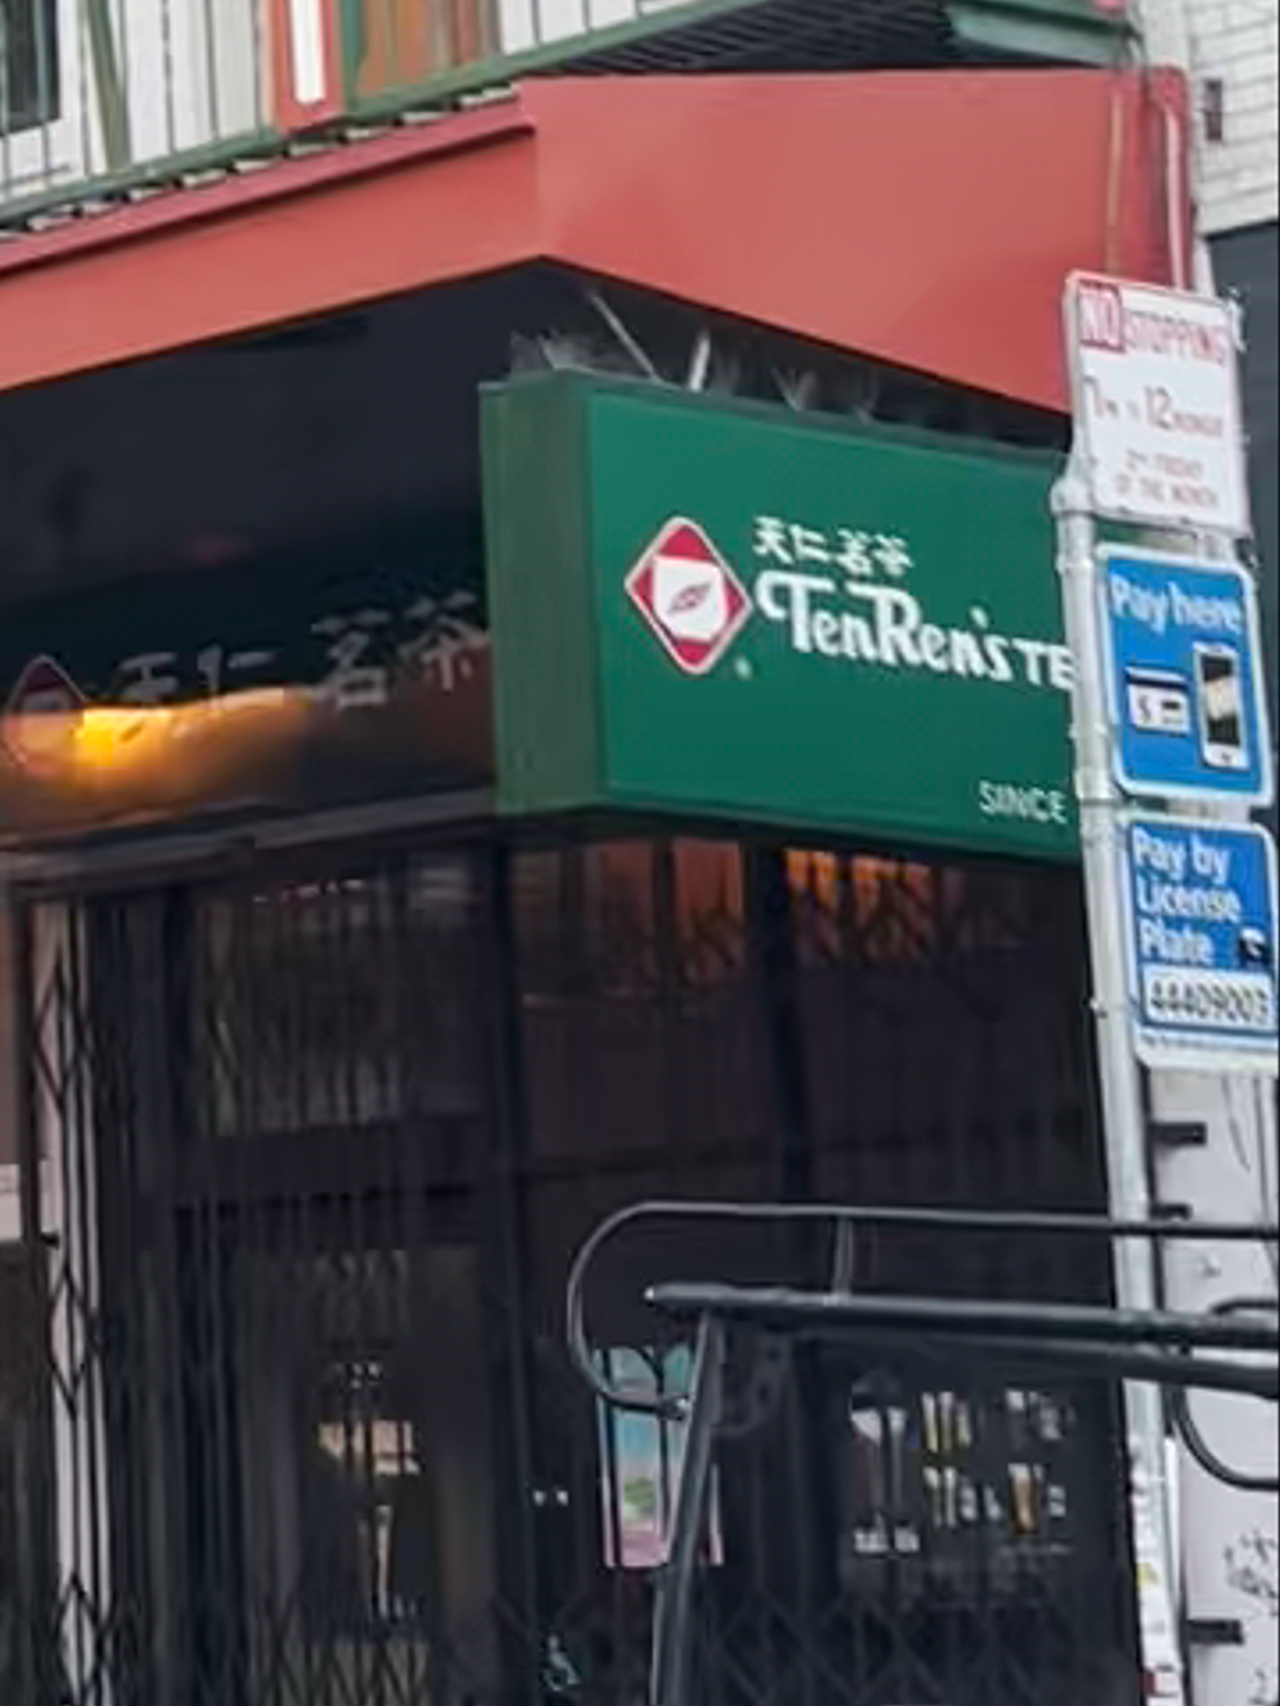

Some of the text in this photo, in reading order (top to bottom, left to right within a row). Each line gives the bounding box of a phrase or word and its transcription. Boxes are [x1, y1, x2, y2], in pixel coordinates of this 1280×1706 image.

[1109, 570, 1241, 635] Pay here
[979, 780, 1068, 824] SINCE
[1132, 824, 1230, 884] Pay by
[1137, 873, 1242, 924] License
[1140, 915, 1214, 967] Plate
